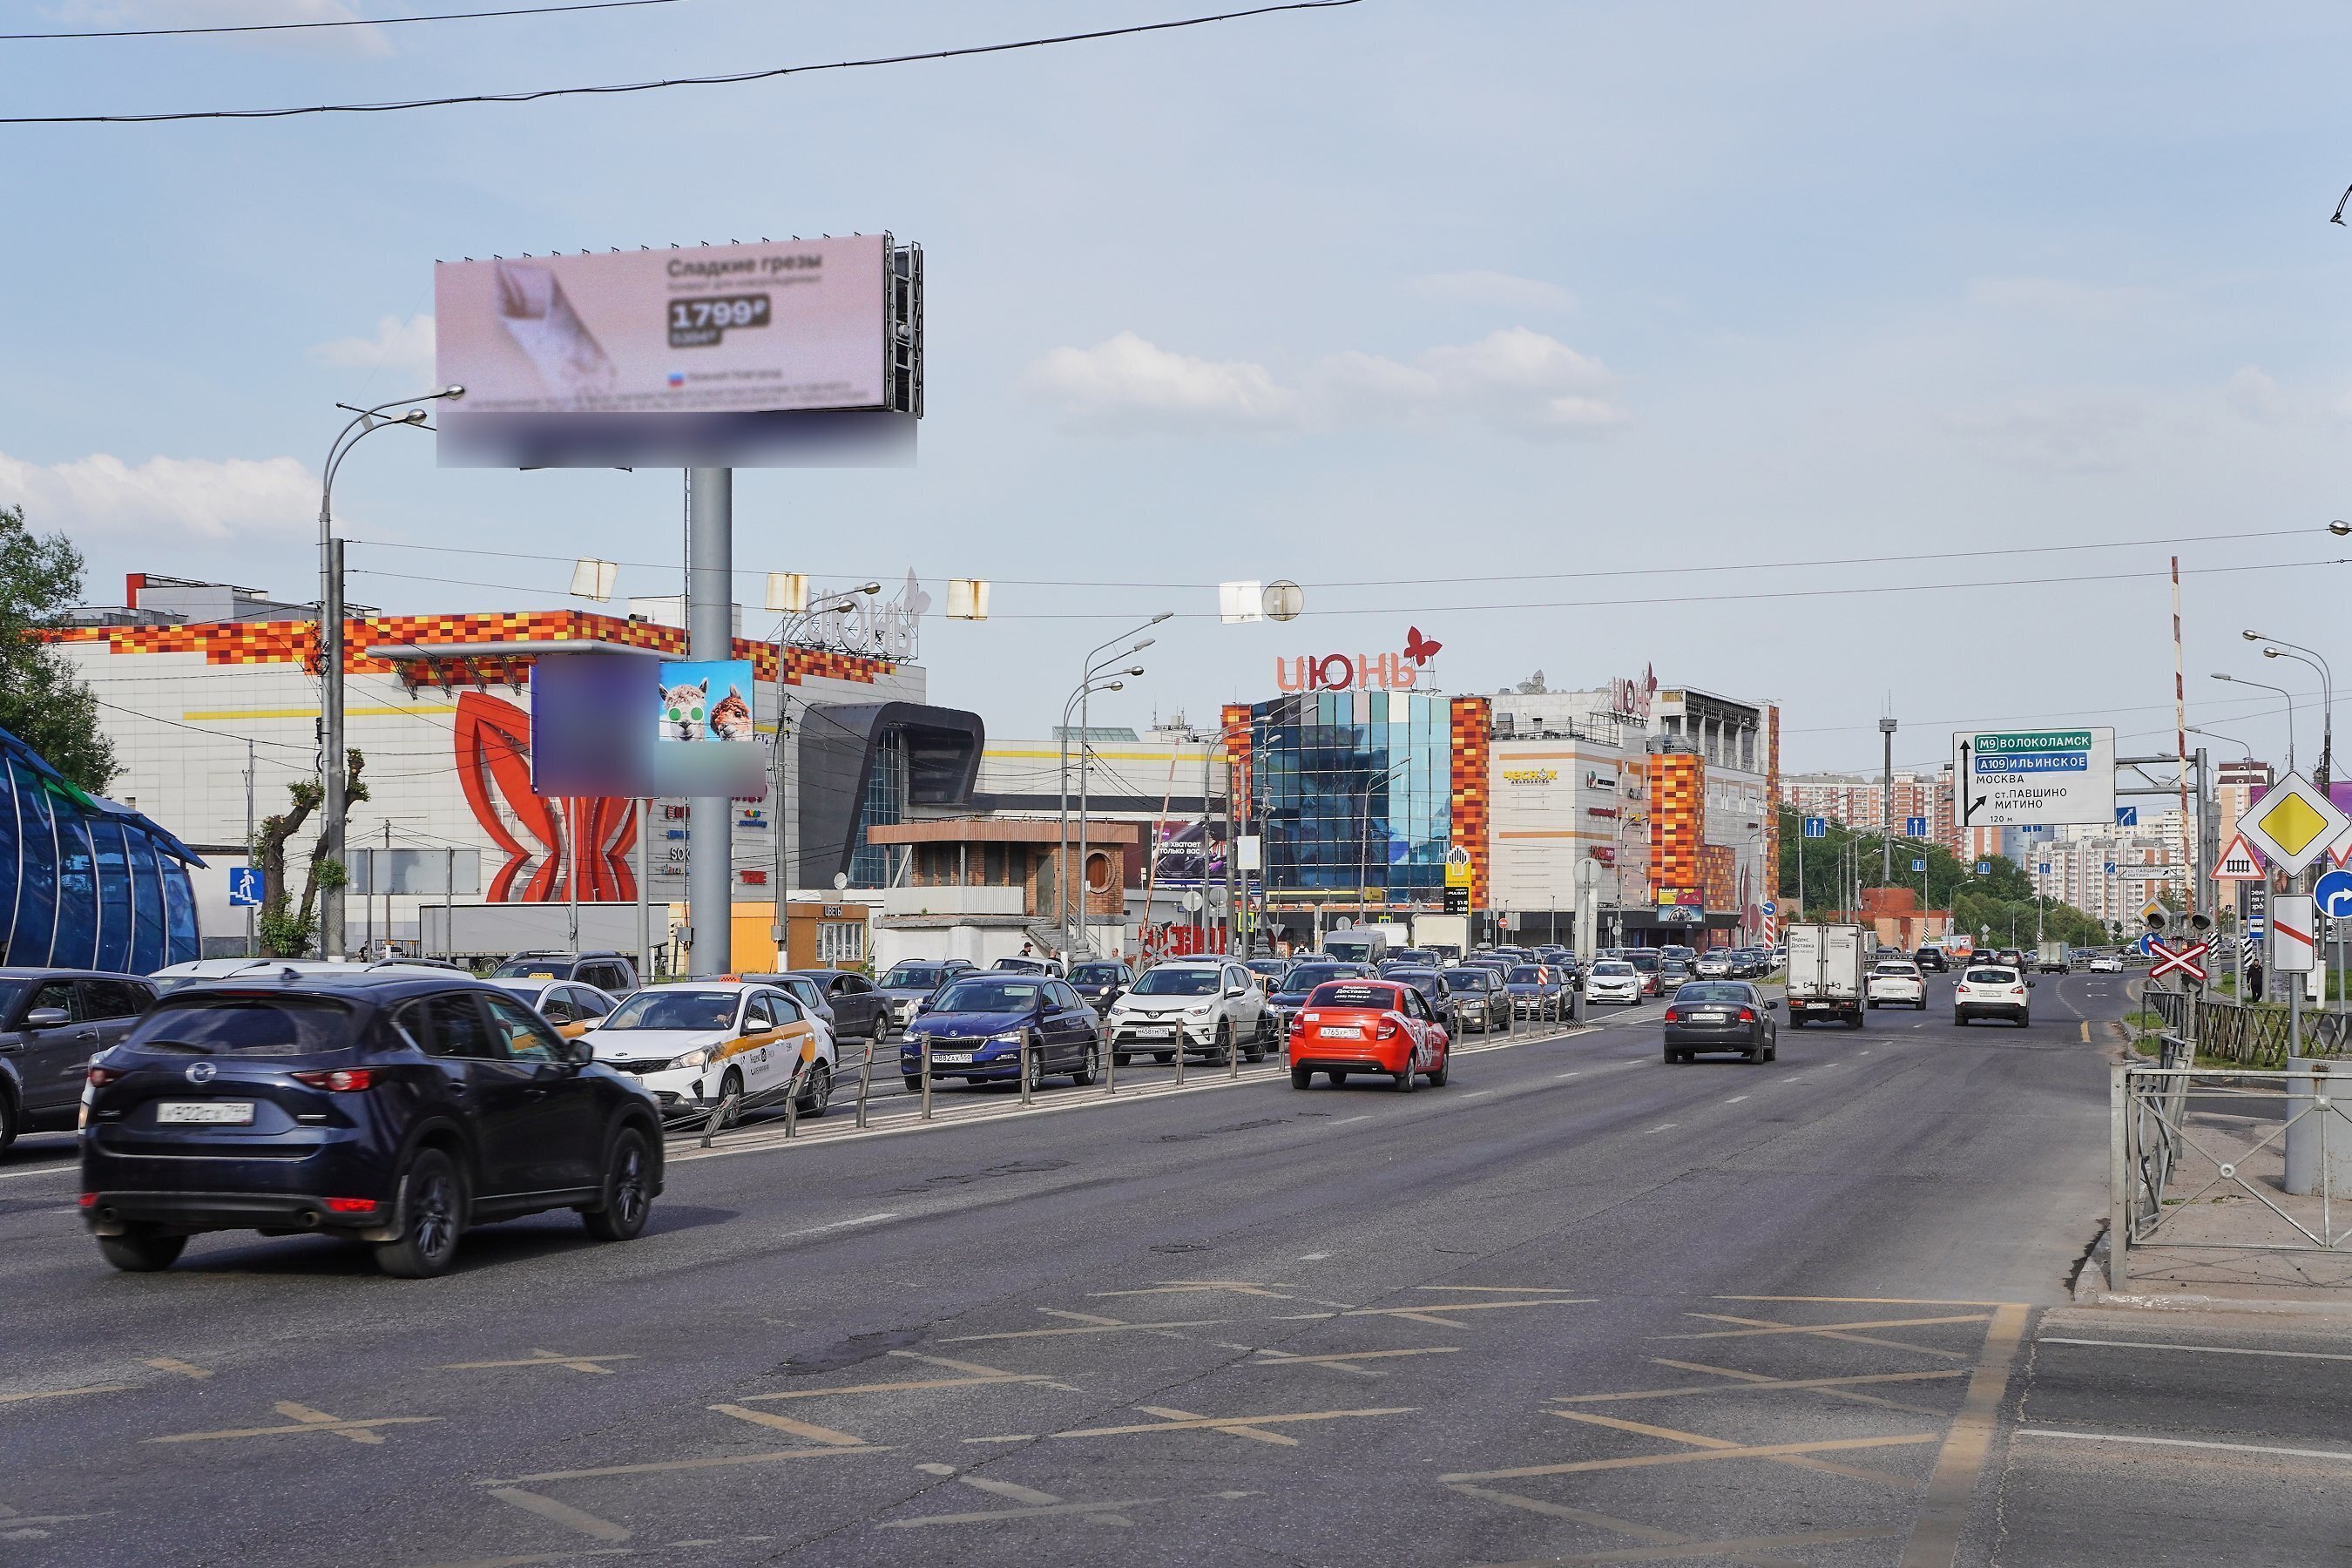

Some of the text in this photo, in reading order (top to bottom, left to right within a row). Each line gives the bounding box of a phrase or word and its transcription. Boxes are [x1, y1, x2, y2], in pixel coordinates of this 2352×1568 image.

[667, 254, 822, 278] Сладкие грезы
[1979, 736, 2090, 749] М9 ВОЛОКОЛАМСК
[1980, 756, 2085, 769] А109 ИЛЬИНСКОЕ
[1977, 774, 2024, 784] МОСКВА
[1995, 799, 2043, 809] МИТИНО
